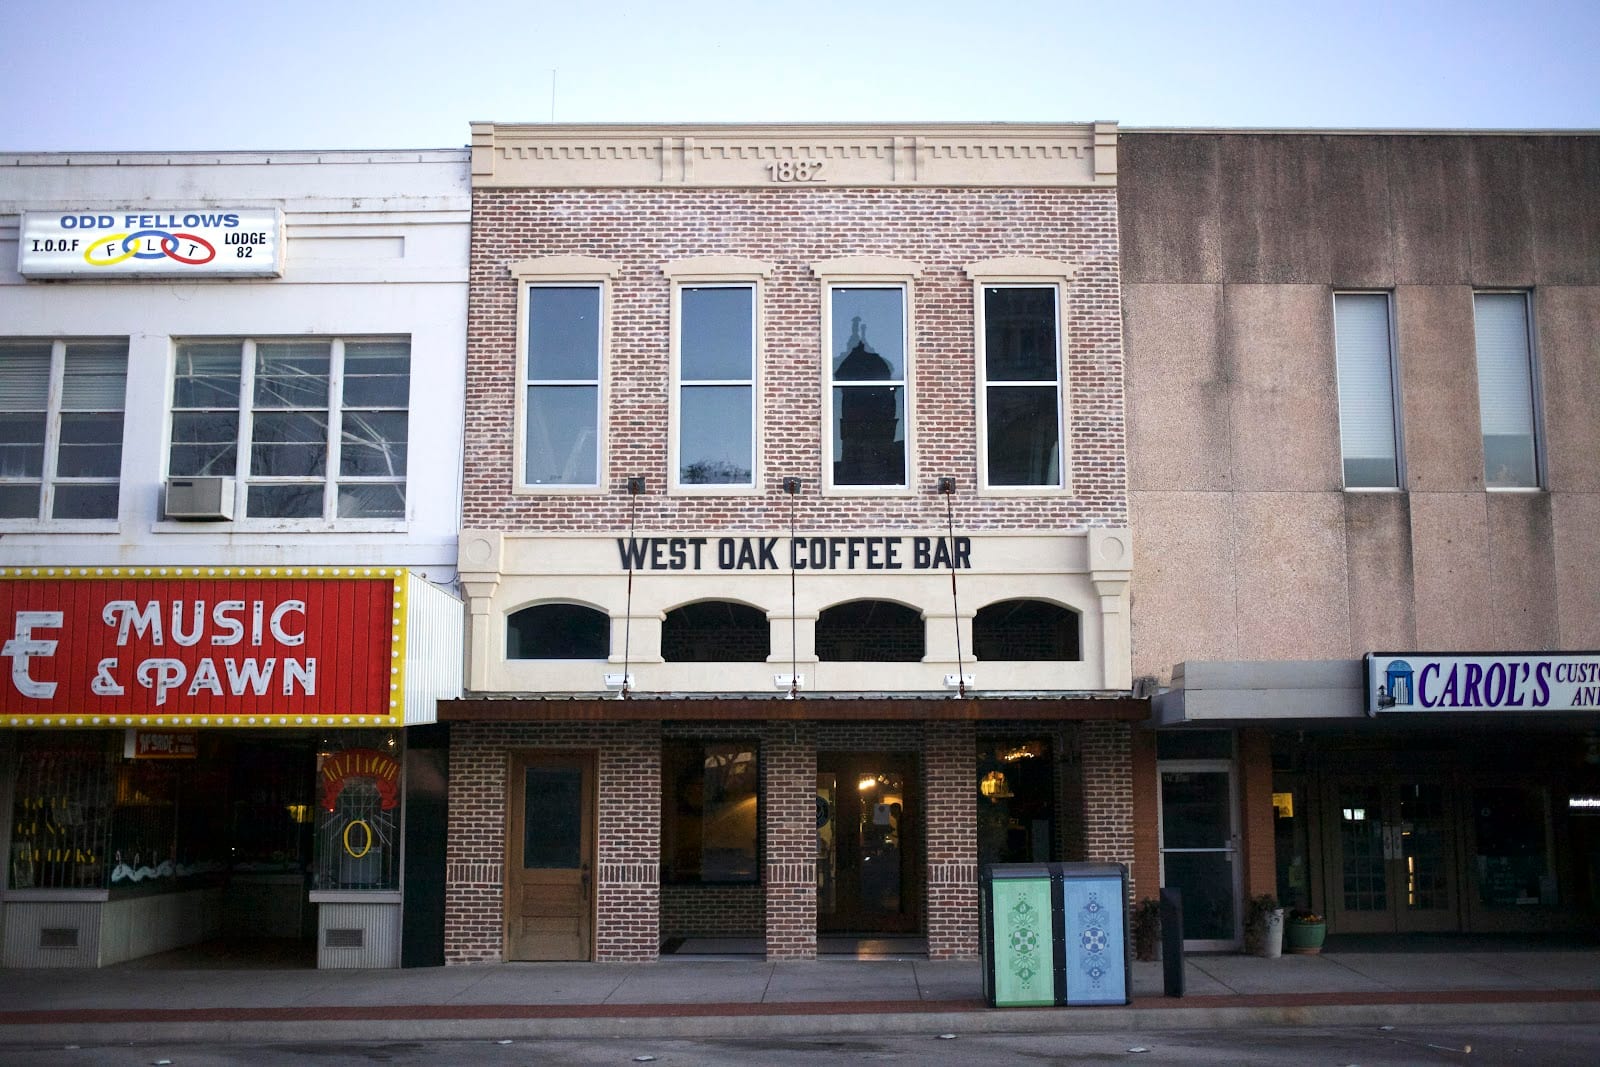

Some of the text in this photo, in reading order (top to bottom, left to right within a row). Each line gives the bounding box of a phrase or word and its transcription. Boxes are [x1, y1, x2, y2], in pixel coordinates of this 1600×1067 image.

[765, 161, 827, 182] 1882
[61, 214, 240, 229] ODD FELLOWS
[106, 239, 199, 257] F L T
[224, 232, 267, 246] LODGE
[237, 246, 253, 258] 82
[617, 537, 972, 570] WEST OAK COFFEE BAR
[102, 599, 306, 647] MUSIC
[91, 657, 317, 706] & PAWN
[1555, 663, 1600, 684] CUST
[1418, 662, 1552, 708] CAROL'S
